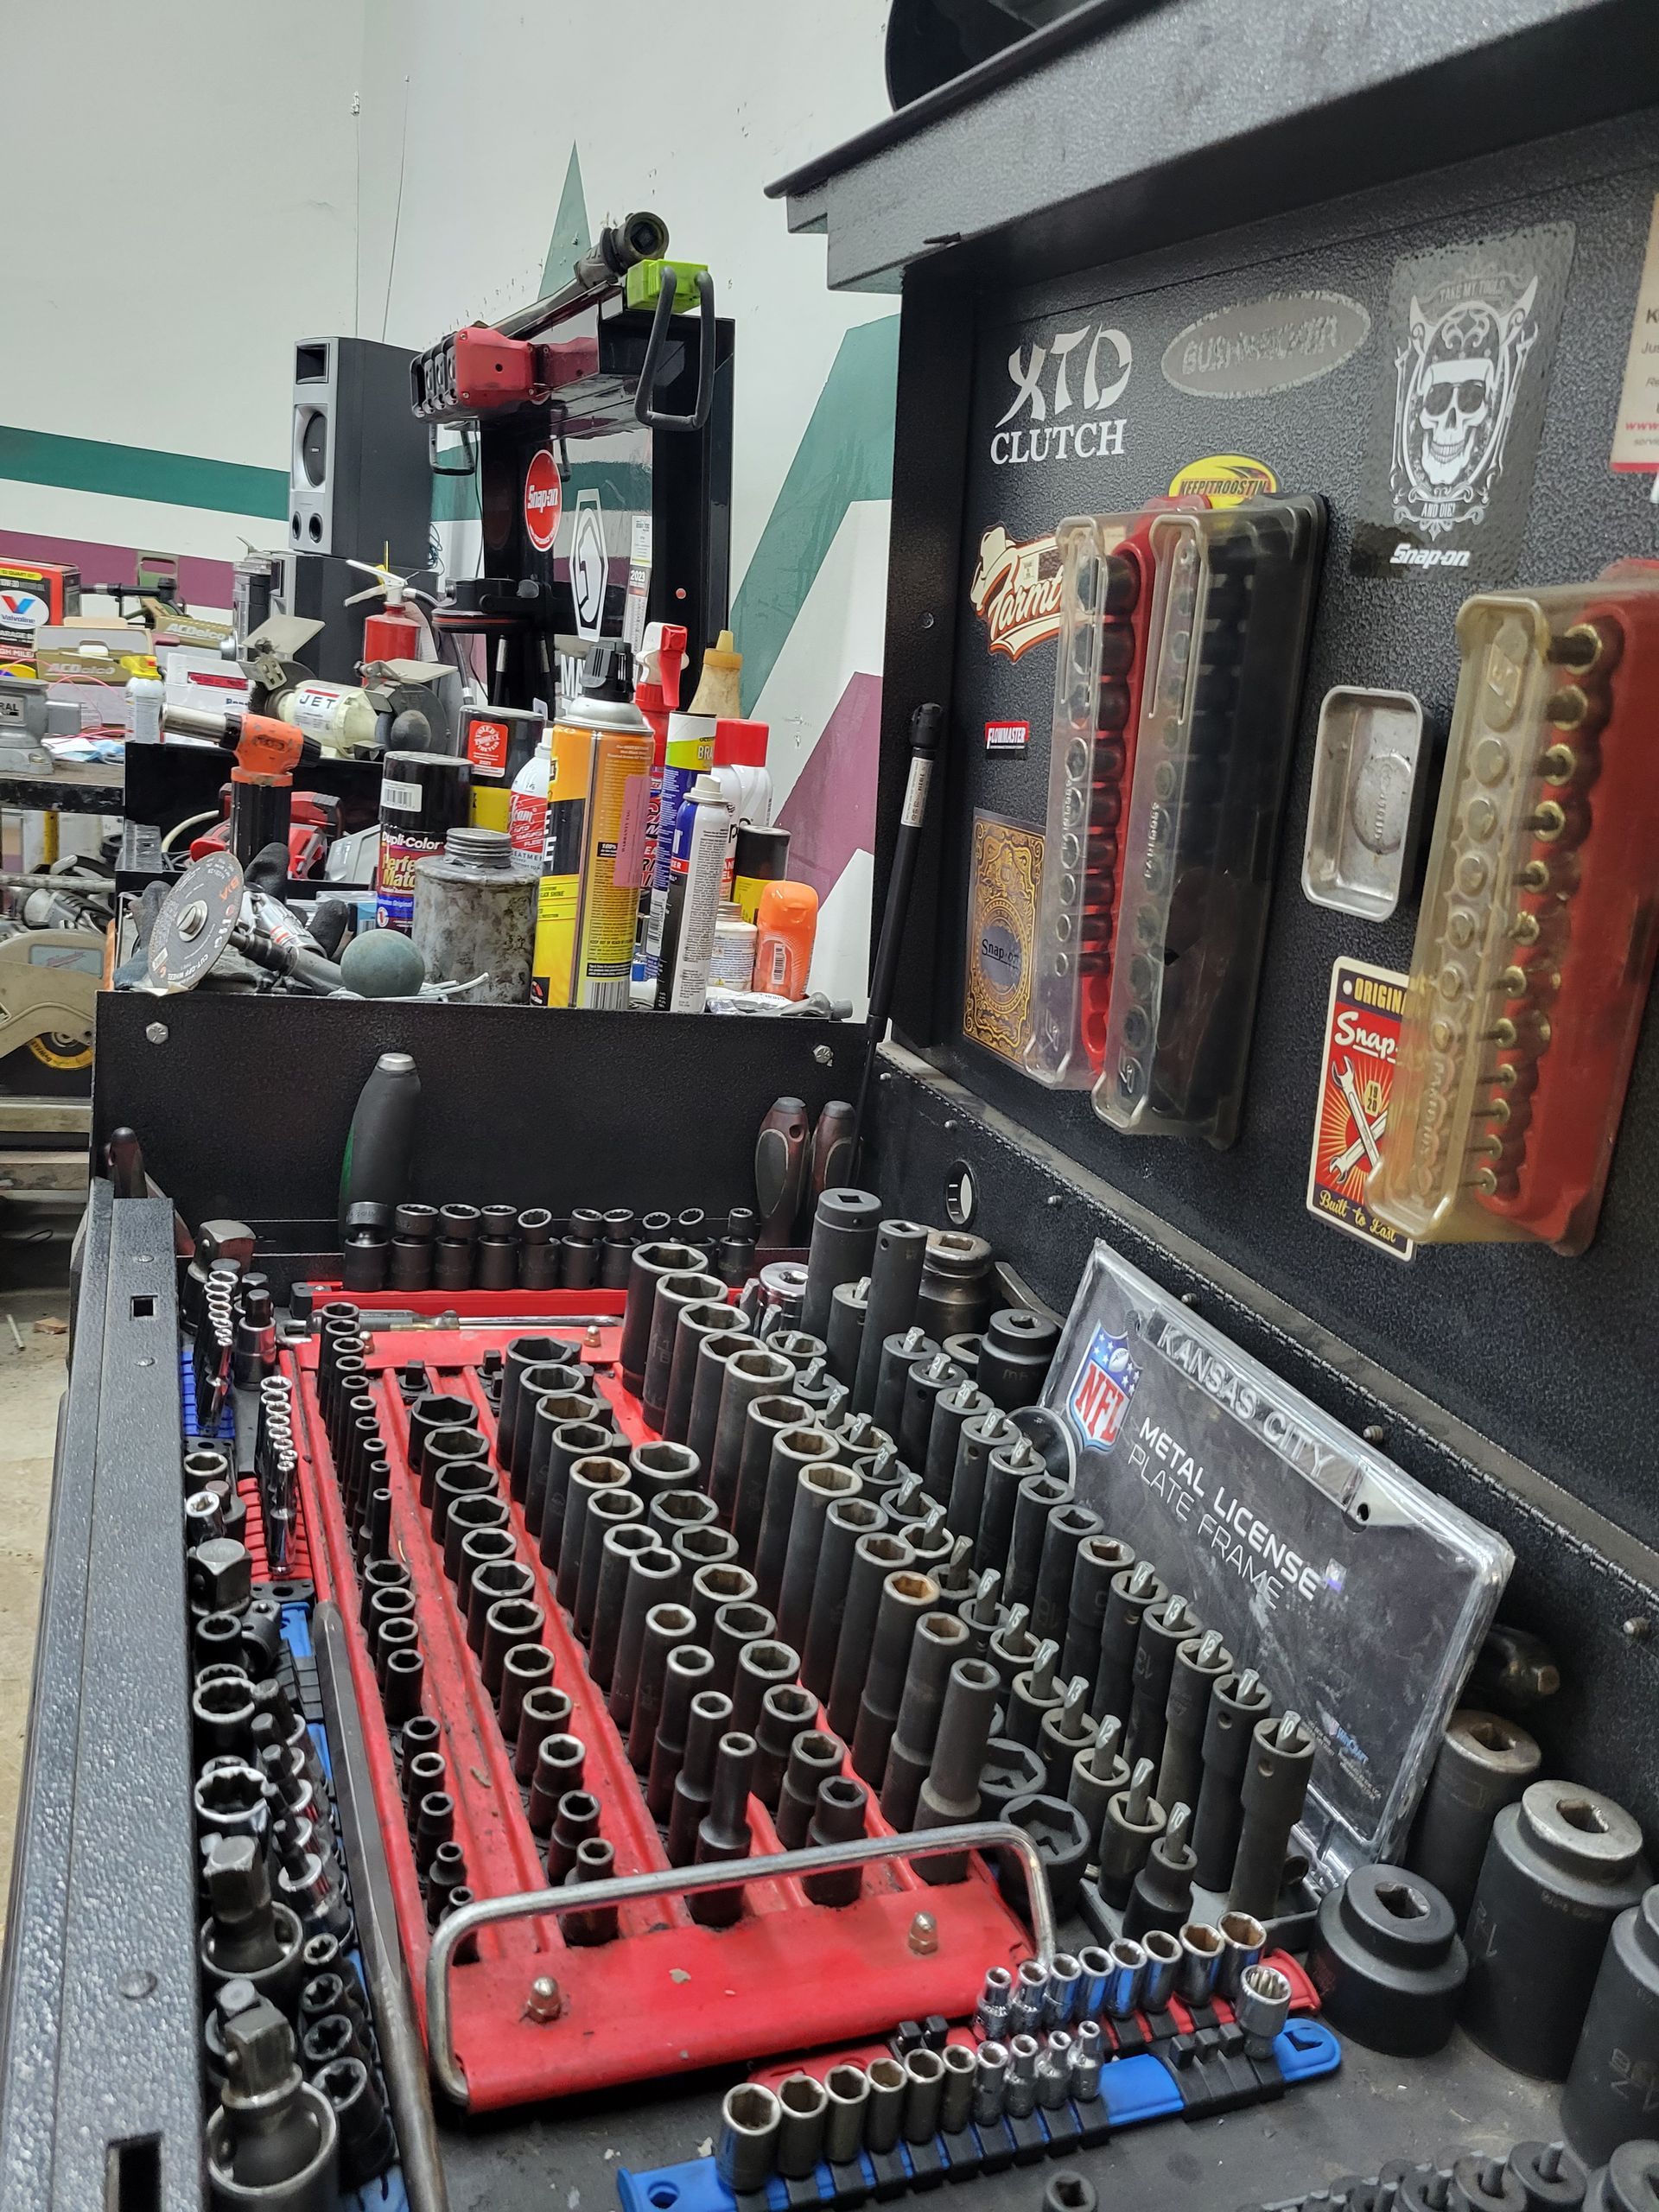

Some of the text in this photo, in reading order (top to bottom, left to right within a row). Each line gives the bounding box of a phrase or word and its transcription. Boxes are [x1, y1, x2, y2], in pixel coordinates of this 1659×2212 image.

[995, 321, 1133, 429] XTD
[990, 419, 1128, 465] CLUTCH
[528, 485, 558, 513] Snap-on
[1421, 503, 1456, 518] AND DIE!
[1389, 543, 1471, 569] Snap-on
[630, 570, 645, 582] 2023
[987, 553, 1065, 642] Farmt
[1, 614, 35, 624] Valvoline
[166, 623, 226, 640] ACDelco
[299, 695, 337, 709] JET
[987, 728, 1027, 750] FLOWMASTER
[382, 830, 440, 850] Dupli-Color
[383, 854, 416, 872] Perfe
[982, 938, 1020, 963] Snap-on
[1370, 1085, 1378, 1098] 19
[1367, 1098, 1377, 1112] 20
[1319, 1190, 1398, 1243] Built to Last
[1075, 1363, 1124, 1445] NFL
[1155, 1322, 1334, 1478] KANSAS CITY
[984, 1413, 996, 1428] 19
[1139, 1417, 1324, 1601] METAL LICENSE
[1128, 1444, 1285, 1610] PLATE FRAME
[980, 1573, 993, 1591] 16
[1134, 1567, 1147, 1592] 14
[1009, 1608, 1022, 1627] 15
[1166, 1598, 1180, 1618] 13
[1038, 1644, 1052, 1662] 14
[1201, 1638, 1217, 1656] 12
[1068, 1679, 1081, 1700] 13
[1099, 1723, 1114, 1743] 12
[1280, 1715, 1294, 1735] 10
[1171, 1807, 1185, 1827] 10
